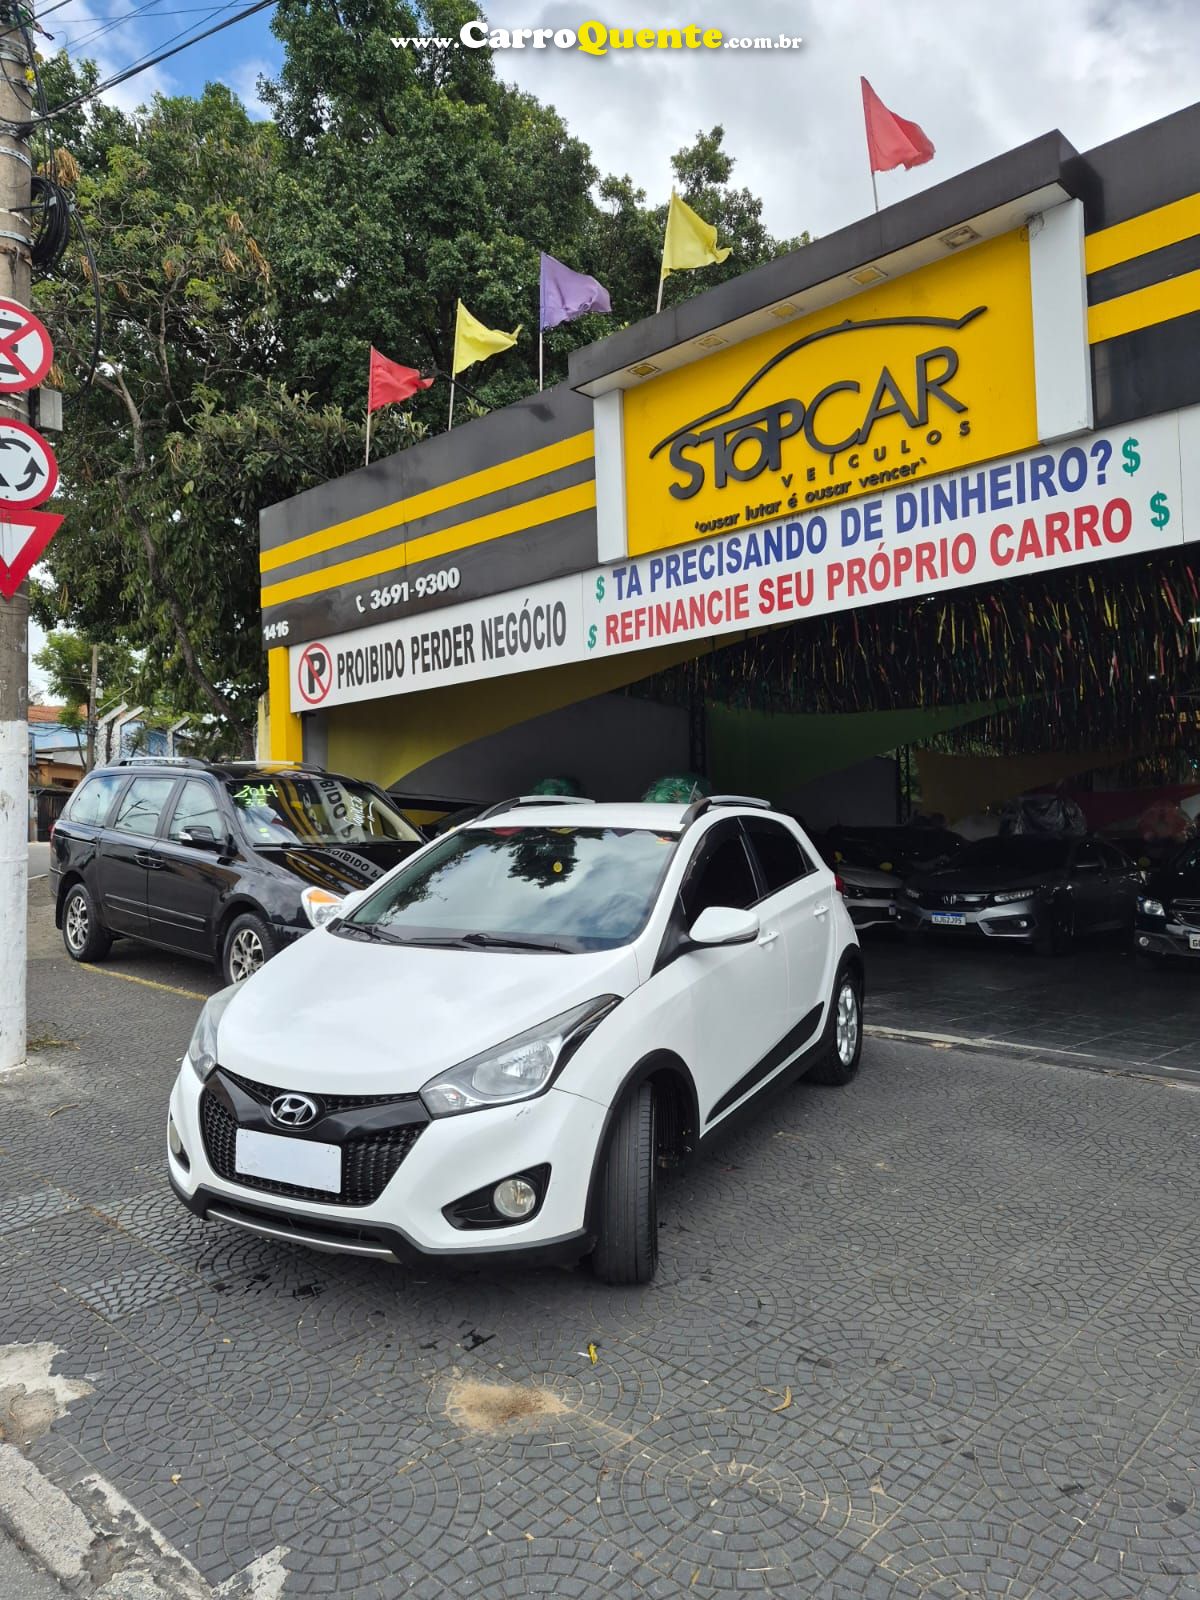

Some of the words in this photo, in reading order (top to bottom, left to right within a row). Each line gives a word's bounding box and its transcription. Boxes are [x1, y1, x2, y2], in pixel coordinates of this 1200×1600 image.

[668, 346, 968, 500] STOPCAR
[612, 565, 642, 600] TA
[650, 516, 828, 593] PRECISANDO
[841, 500, 883, 548] DE
[896, 439, 1113, 534] DINHEIRO?
[745, 499, 781, 520] lutar
[787, 493, 798, 509] é
[805, 481, 852, 504] ousar
[370, 567, 460, 610] 3691-9300
[605, 584, 750, 646] REFINANCIE
[758, 569, 814, 615] SEU
[826, 542, 977, 601] PRÓPRIO
[989, 498, 1132, 567] CARRO
[263, 621, 289, 640] 1416
[337, 639, 405, 689] PROIBIDO
[411, 623, 475, 675] PERDER
[481, 598, 567, 661] NEGÓCIO
